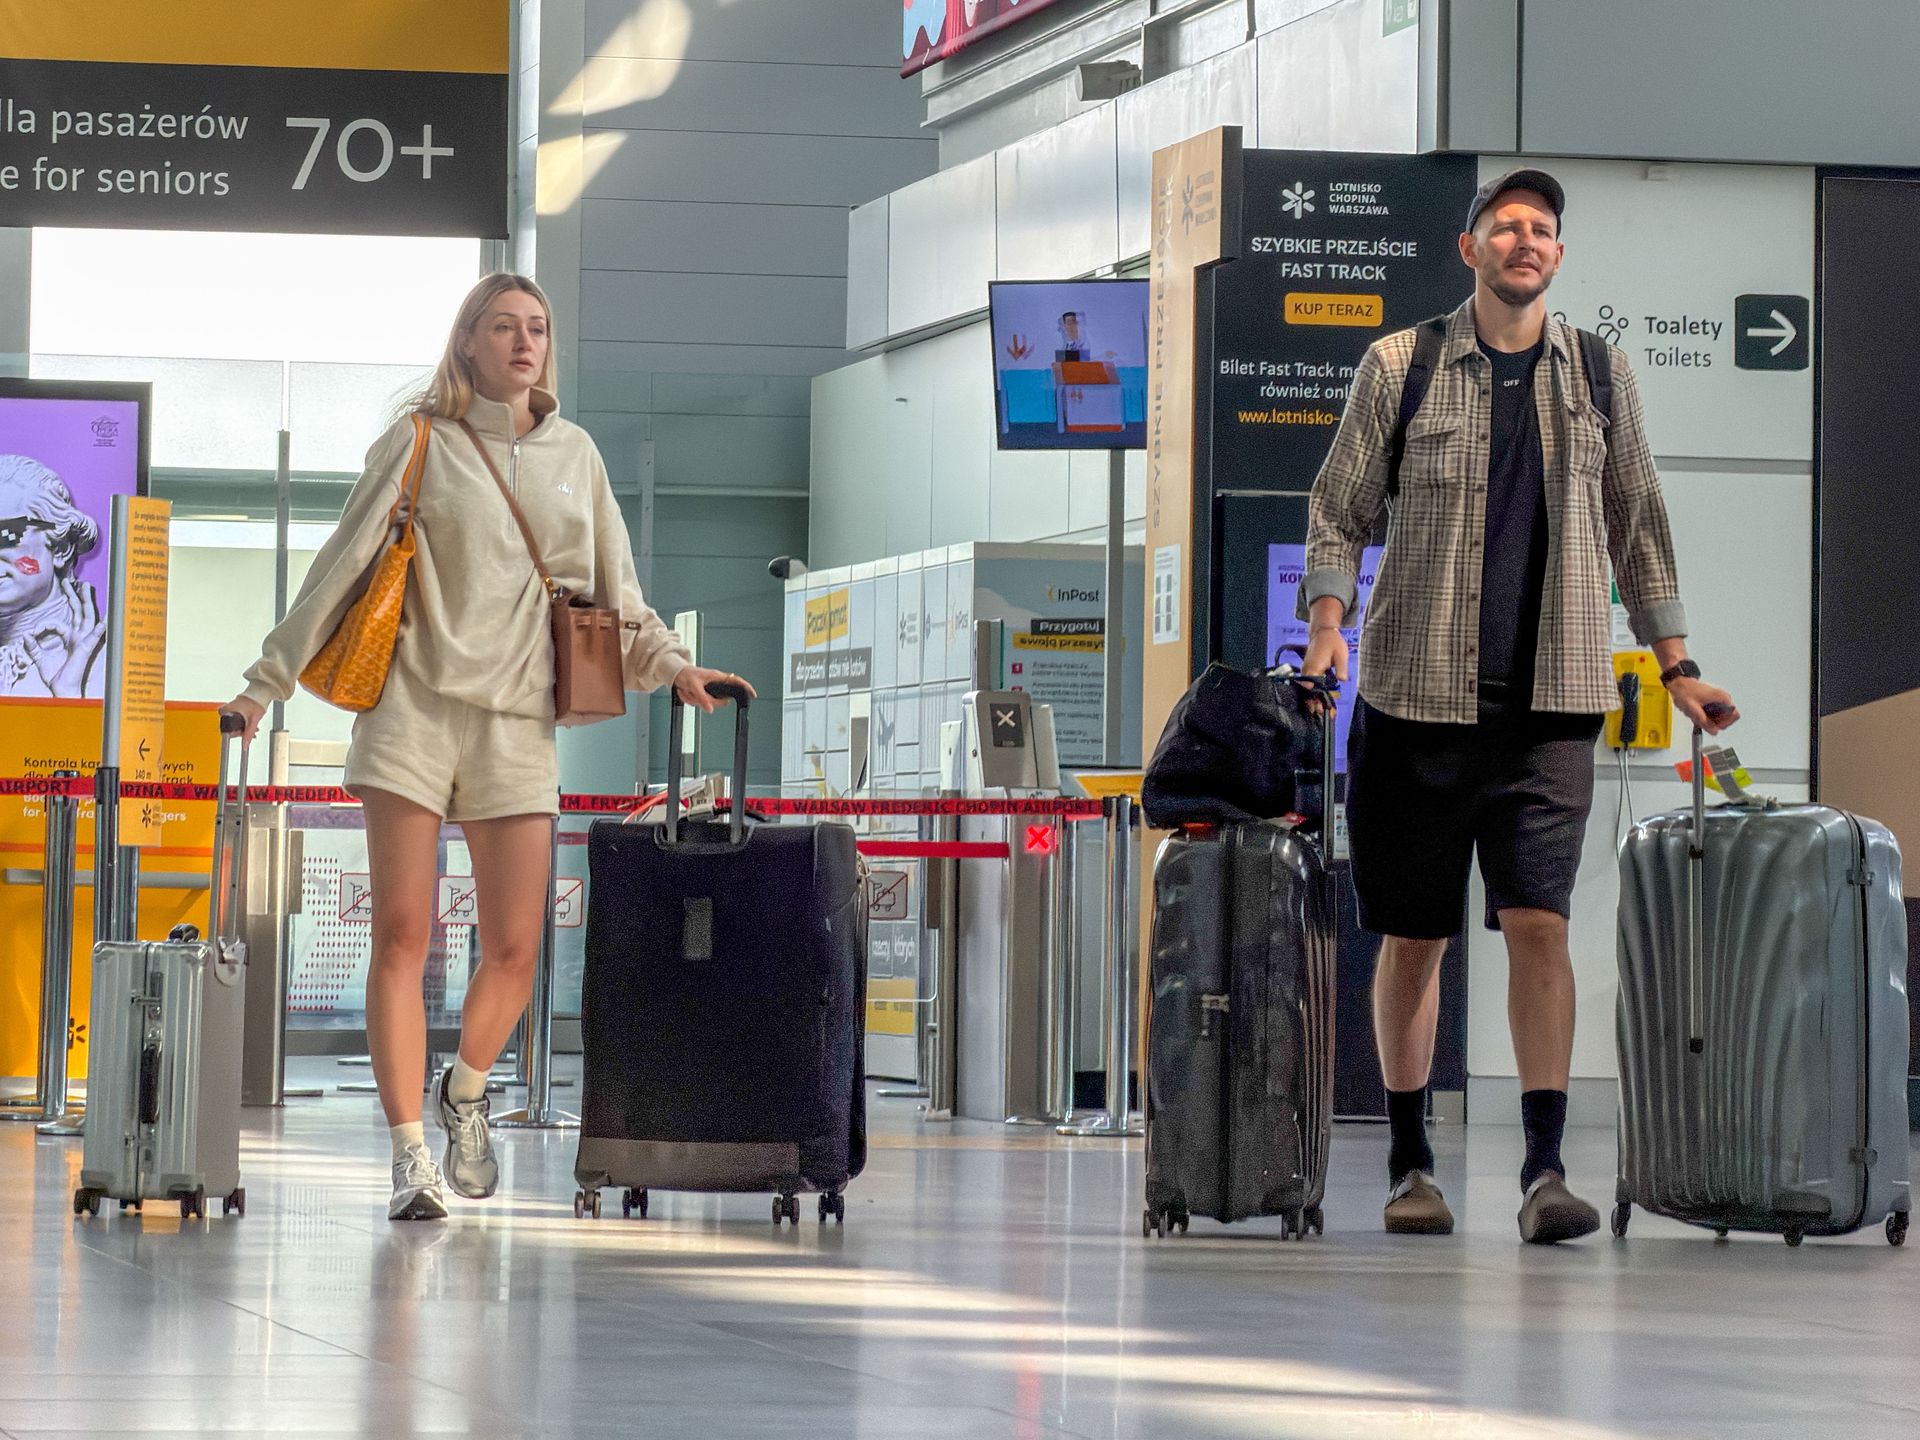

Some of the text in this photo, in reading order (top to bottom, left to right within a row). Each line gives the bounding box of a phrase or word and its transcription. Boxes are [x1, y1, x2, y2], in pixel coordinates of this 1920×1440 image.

[0, 98, 250, 144] la pasażerów
[285, 117, 455, 191] 70+
[32, 156, 85, 192] for
[97, 160, 230, 196] seniors
[1329, 182, 1382, 194] LOTNISKO
[1329, 193, 1377, 204] CHOPINA
[1329, 204, 1389, 216] WARSZAWA
[1251, 237, 1417, 257] SZYBKIE PRZEJŚCIE
[1281, 263, 1386, 281] FAST TRACK
[1294, 302, 1374, 318] KUP TERAZ
[1645, 315, 1723, 341] Toalety
[1645, 347, 1712, 368] Toilets
[1220, 359, 1255, 375] Bilet
[1259, 361, 1291, 376] Fast
[1294, 362, 1335, 378] Track
[1260, 382, 1320, 399] również
[1237, 408, 1341, 425] www.lotnisko-
[1057, 588, 1100, 602] InPost
[1039, 621, 1100, 633] Przygotuj
[24, 757, 77, 768] Kontrola
[80, 758, 101, 769] kar
[794, 801, 866, 814] WARSAW
